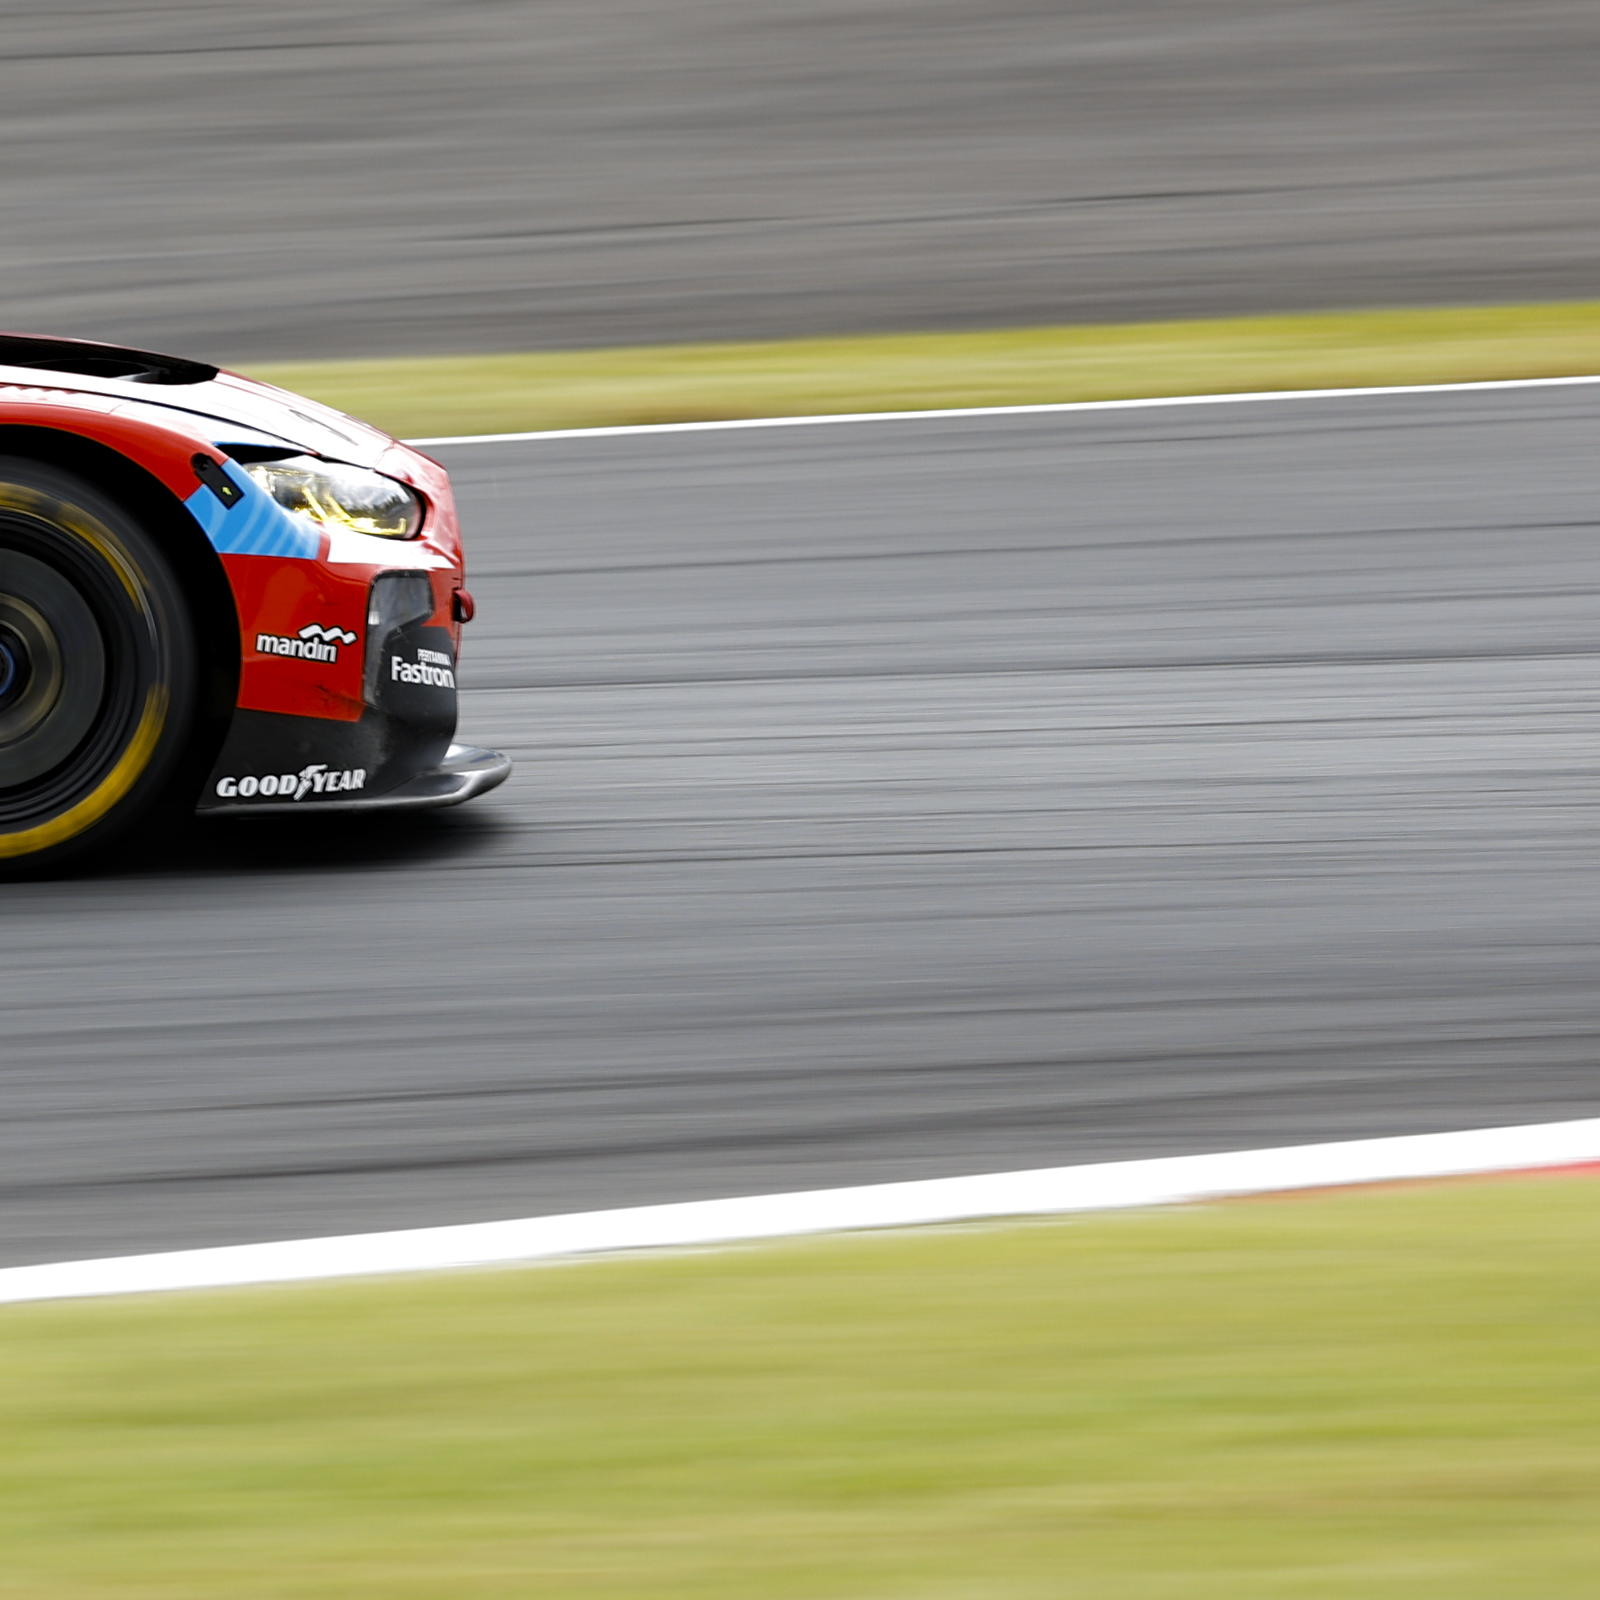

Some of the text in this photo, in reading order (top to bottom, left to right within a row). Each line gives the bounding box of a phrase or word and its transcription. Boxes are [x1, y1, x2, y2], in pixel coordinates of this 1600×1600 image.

[256, 633, 337, 663] mandiri
[391, 656, 456, 689] Fastron
[216, 766, 366, 799] GOODYEAR
